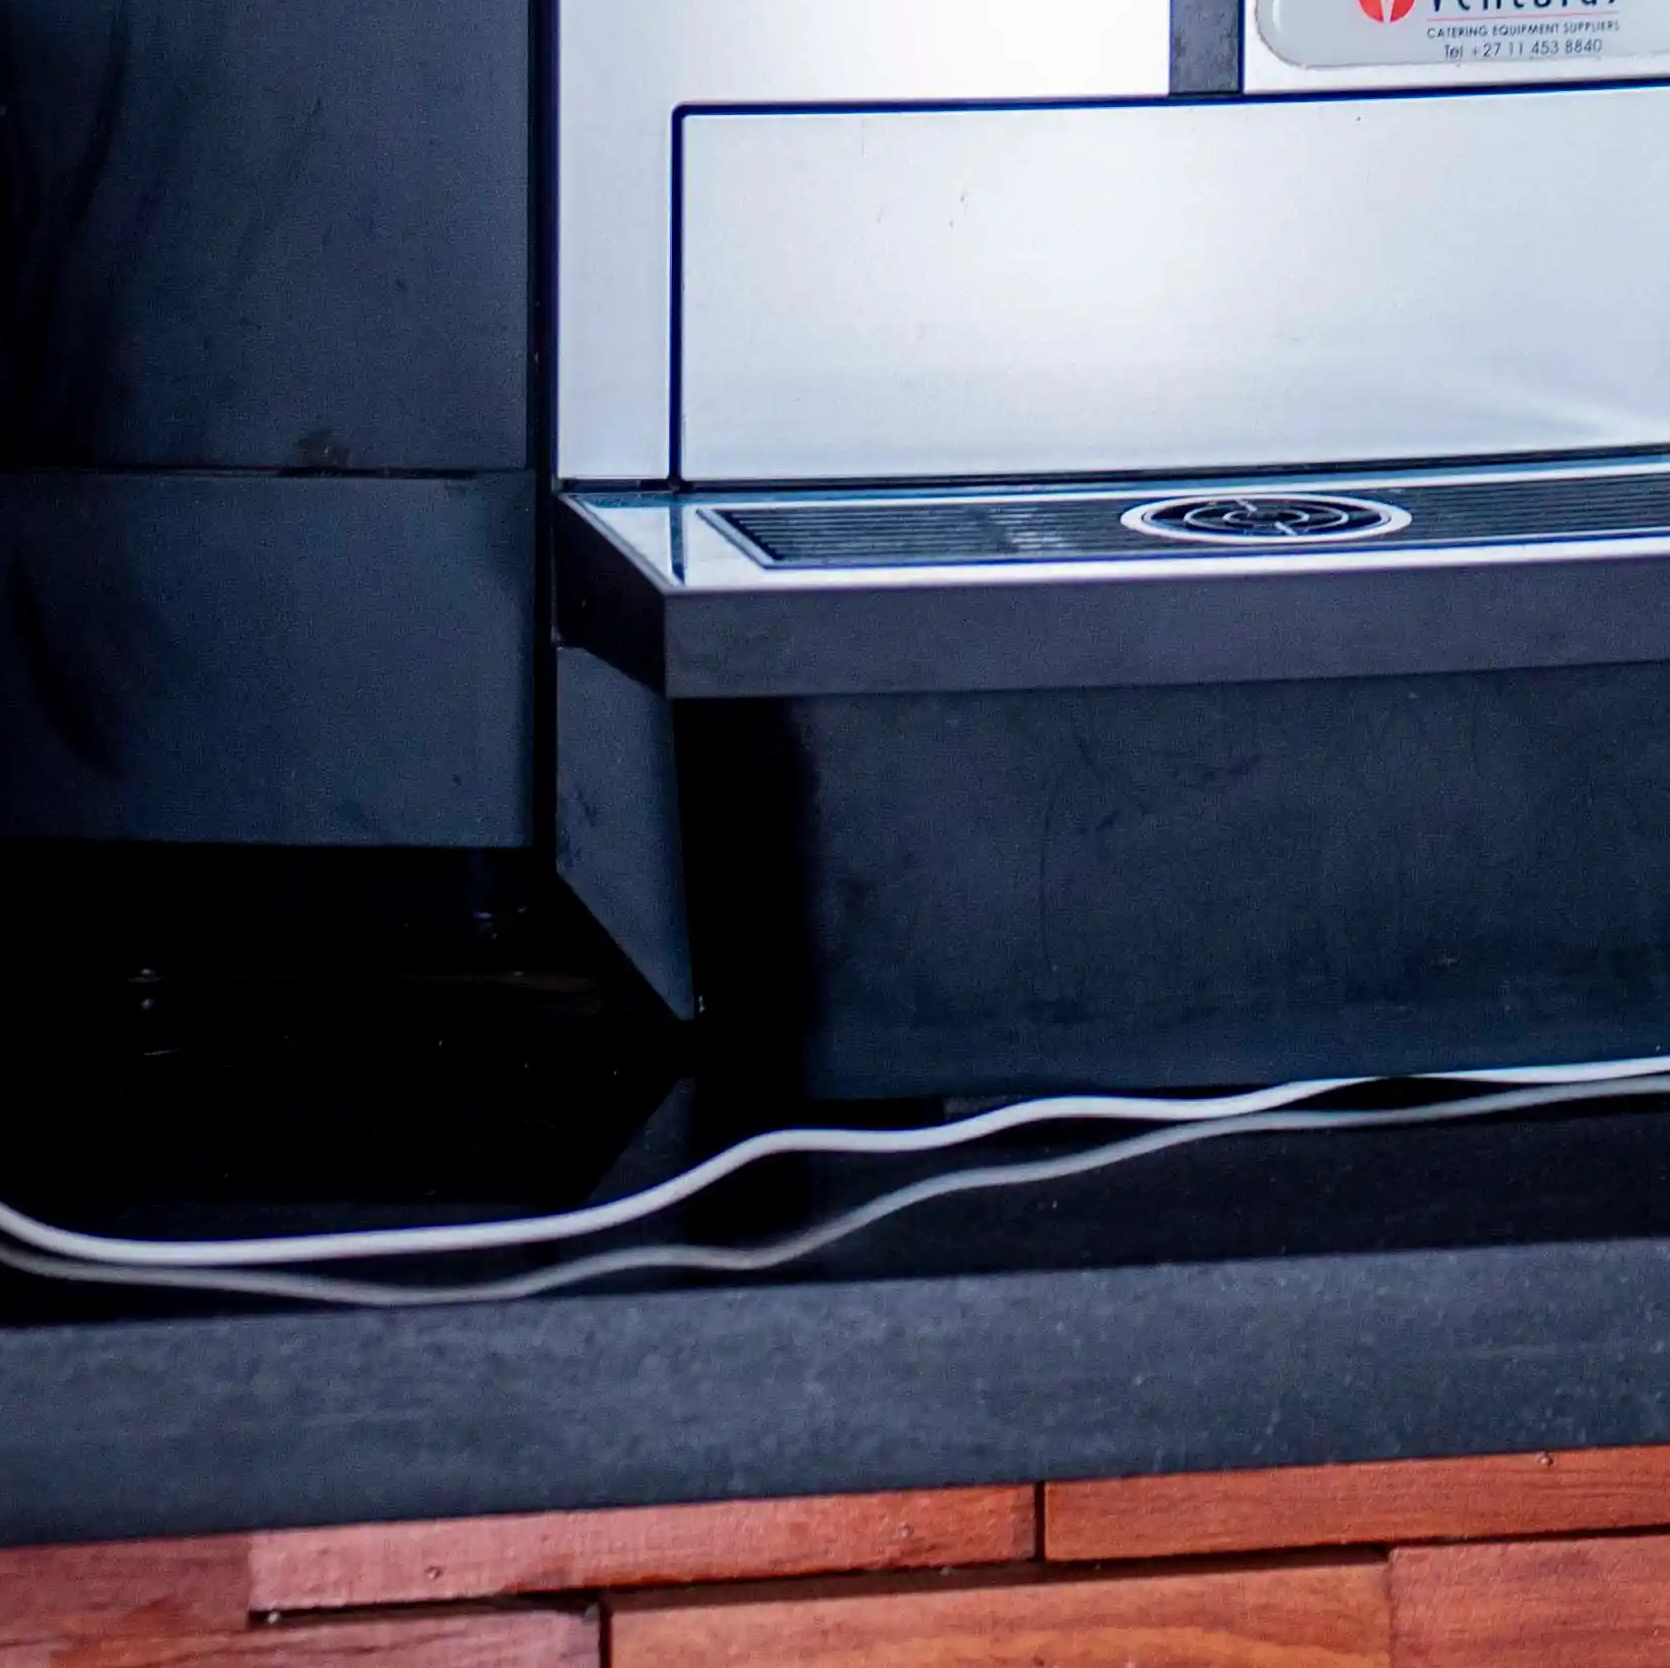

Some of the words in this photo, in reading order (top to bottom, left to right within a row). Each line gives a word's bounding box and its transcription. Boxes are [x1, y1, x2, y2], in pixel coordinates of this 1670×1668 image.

[1426, 26, 1489, 39] CATERING
[1492, 22, 1560, 36] EQUIPMENT
[1563, 19, 1620, 33] SUPPLIERS
[1472, 42, 1502, 57] +27
[1531, 40, 1560, 55] 453
[1565, 38, 1603, 53] 8840
